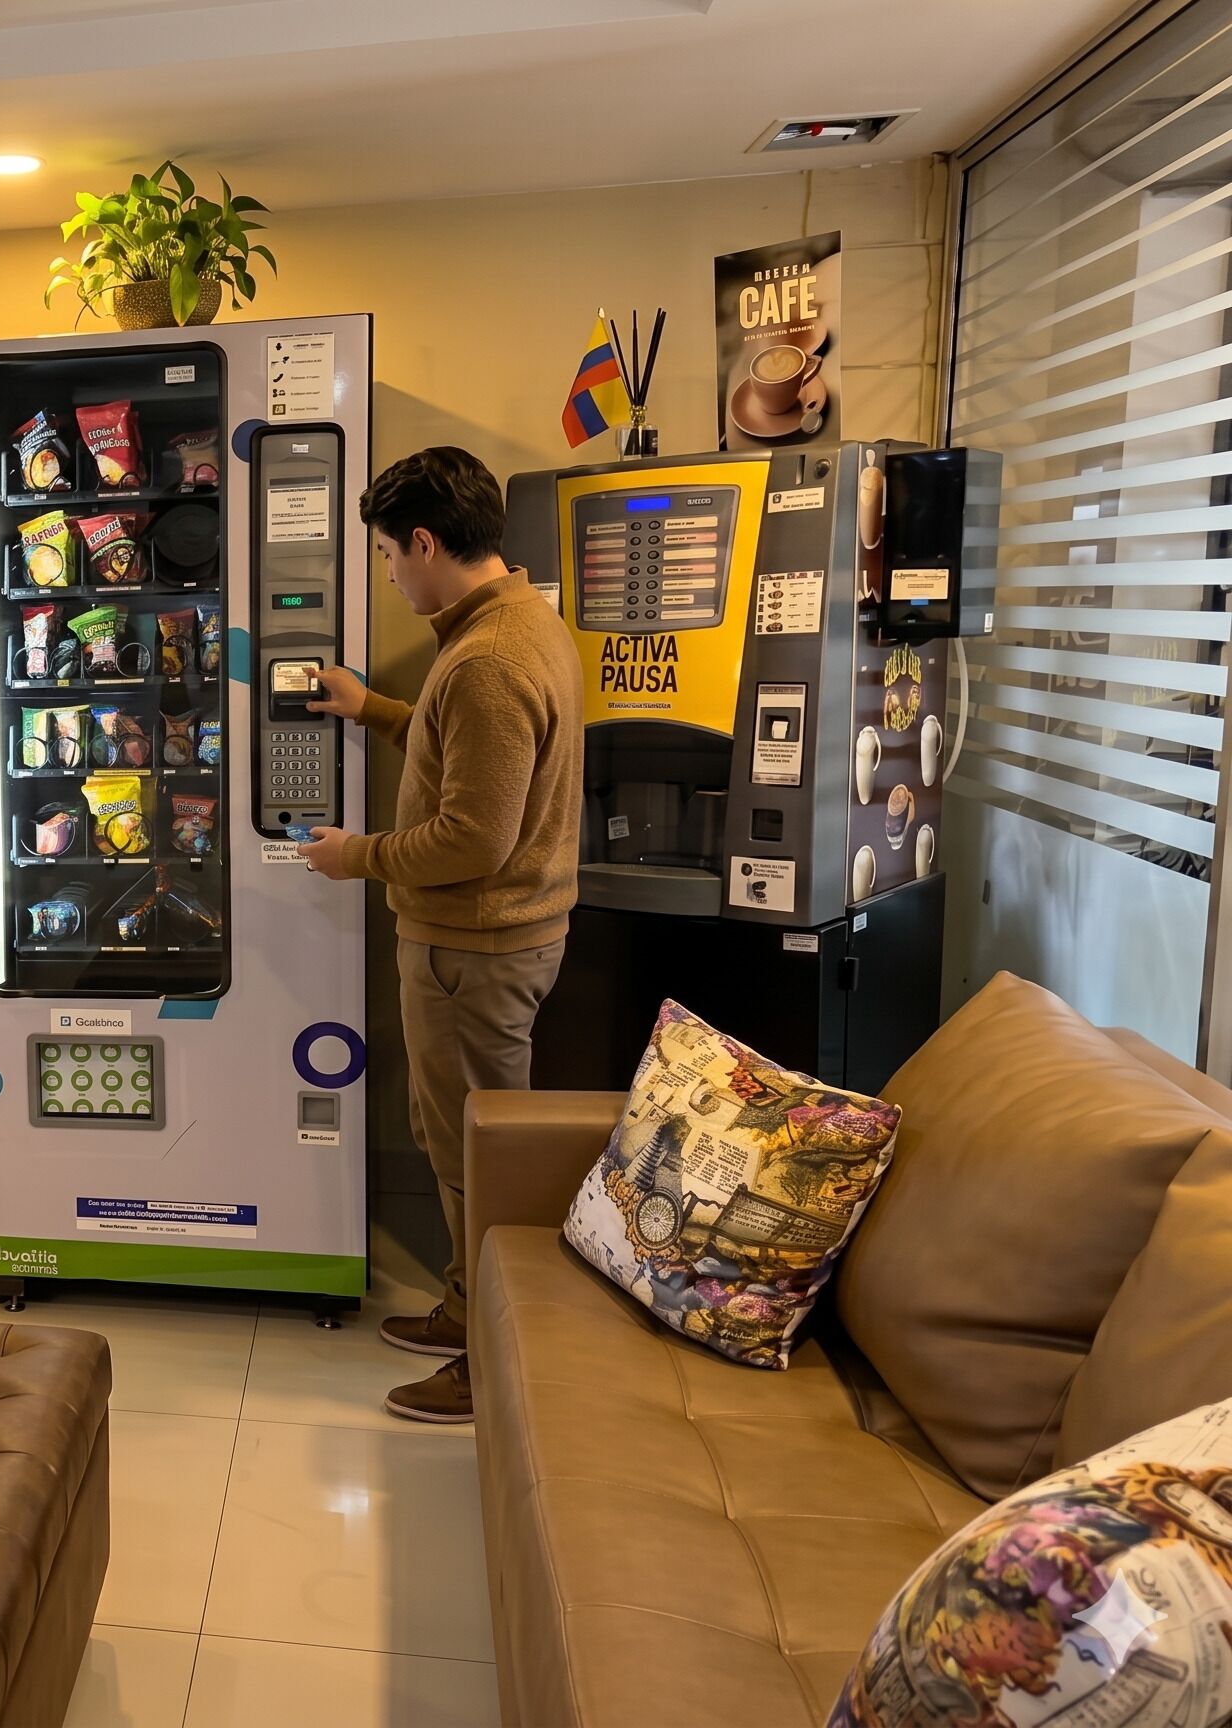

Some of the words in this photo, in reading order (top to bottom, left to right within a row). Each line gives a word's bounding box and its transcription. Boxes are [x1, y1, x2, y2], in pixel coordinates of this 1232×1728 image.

[739, 275, 818, 330] CAFE
[600, 634, 679, 663] ACTIVA
[600, 665, 679, 693] PAUSA
